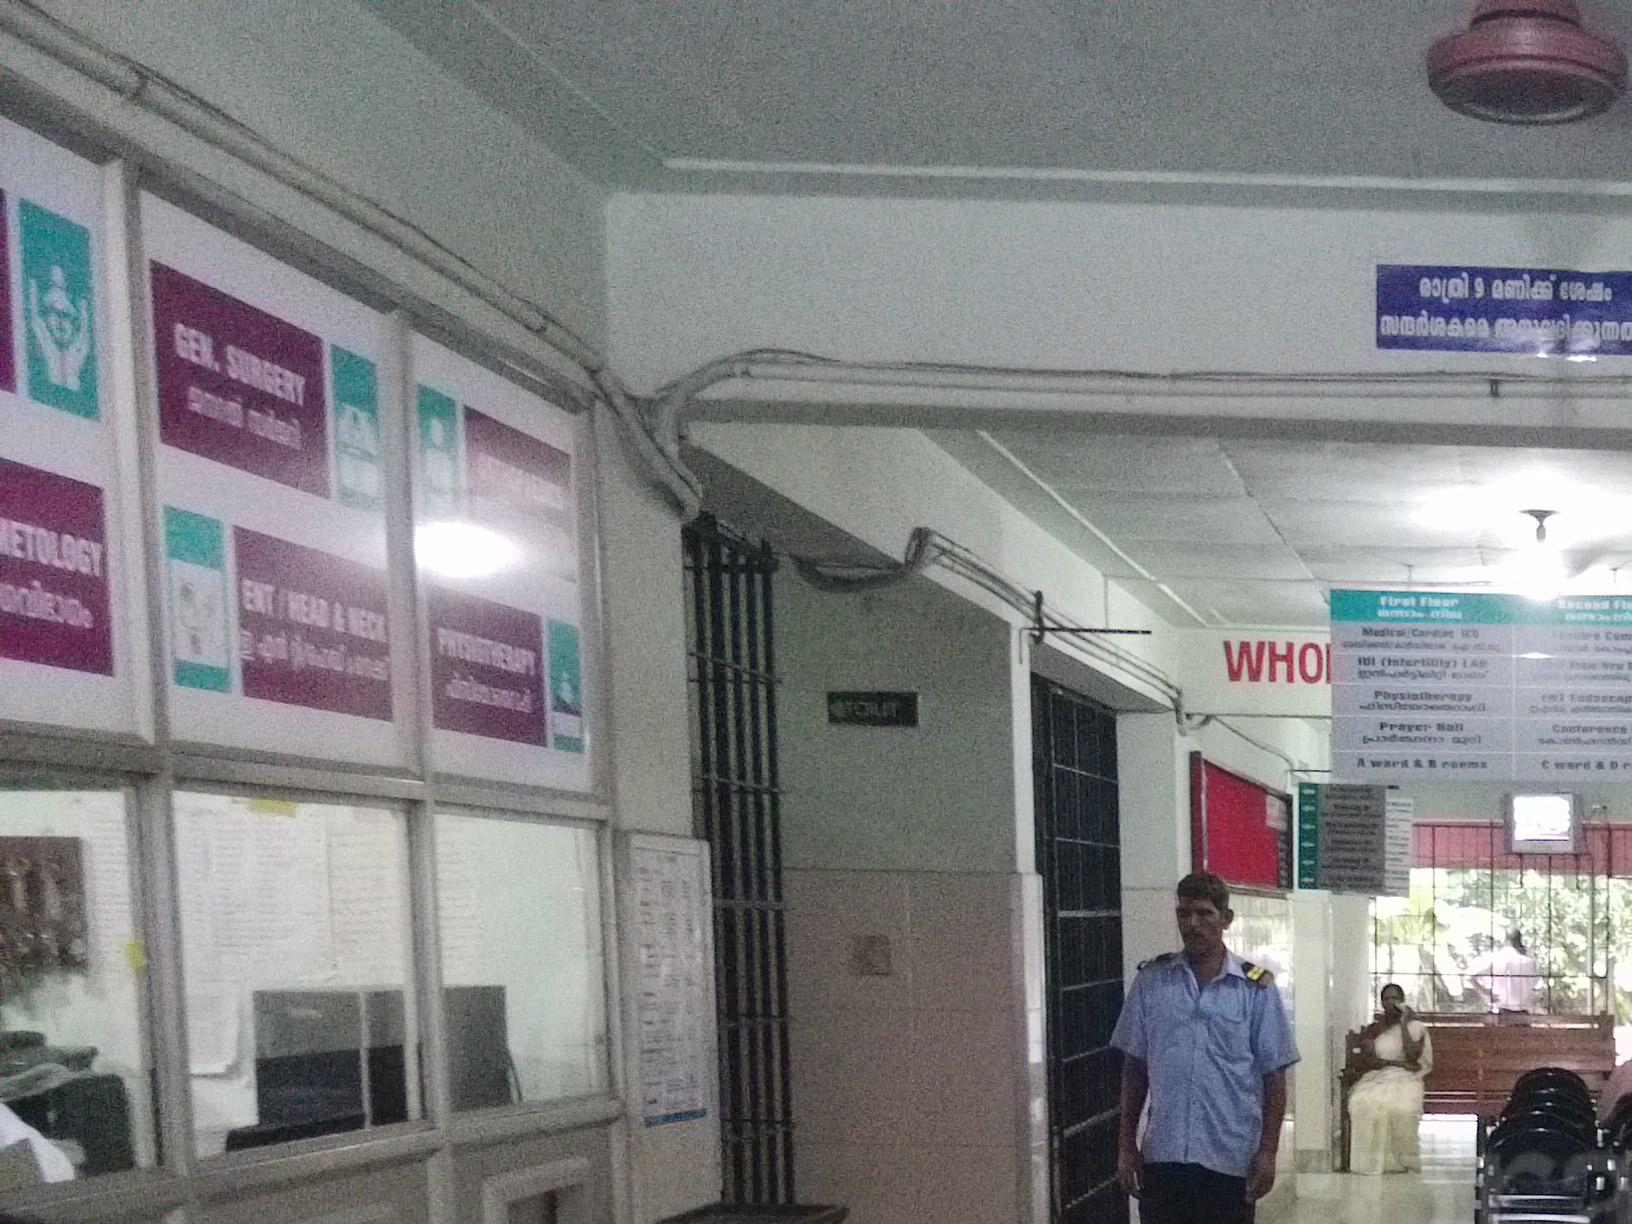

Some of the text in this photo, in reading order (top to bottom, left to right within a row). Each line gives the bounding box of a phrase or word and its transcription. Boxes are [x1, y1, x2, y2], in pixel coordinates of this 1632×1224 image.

[225, 344, 306, 406] SURGERY
[0, 516, 102, 577] ETOLOGY
[1379, 721, 1431, 733] Prayer
[1370, 758, 1409, 769] ward
[1442, 760, 1488, 770] rooms
[1554, 760, 1591, 771] ward
